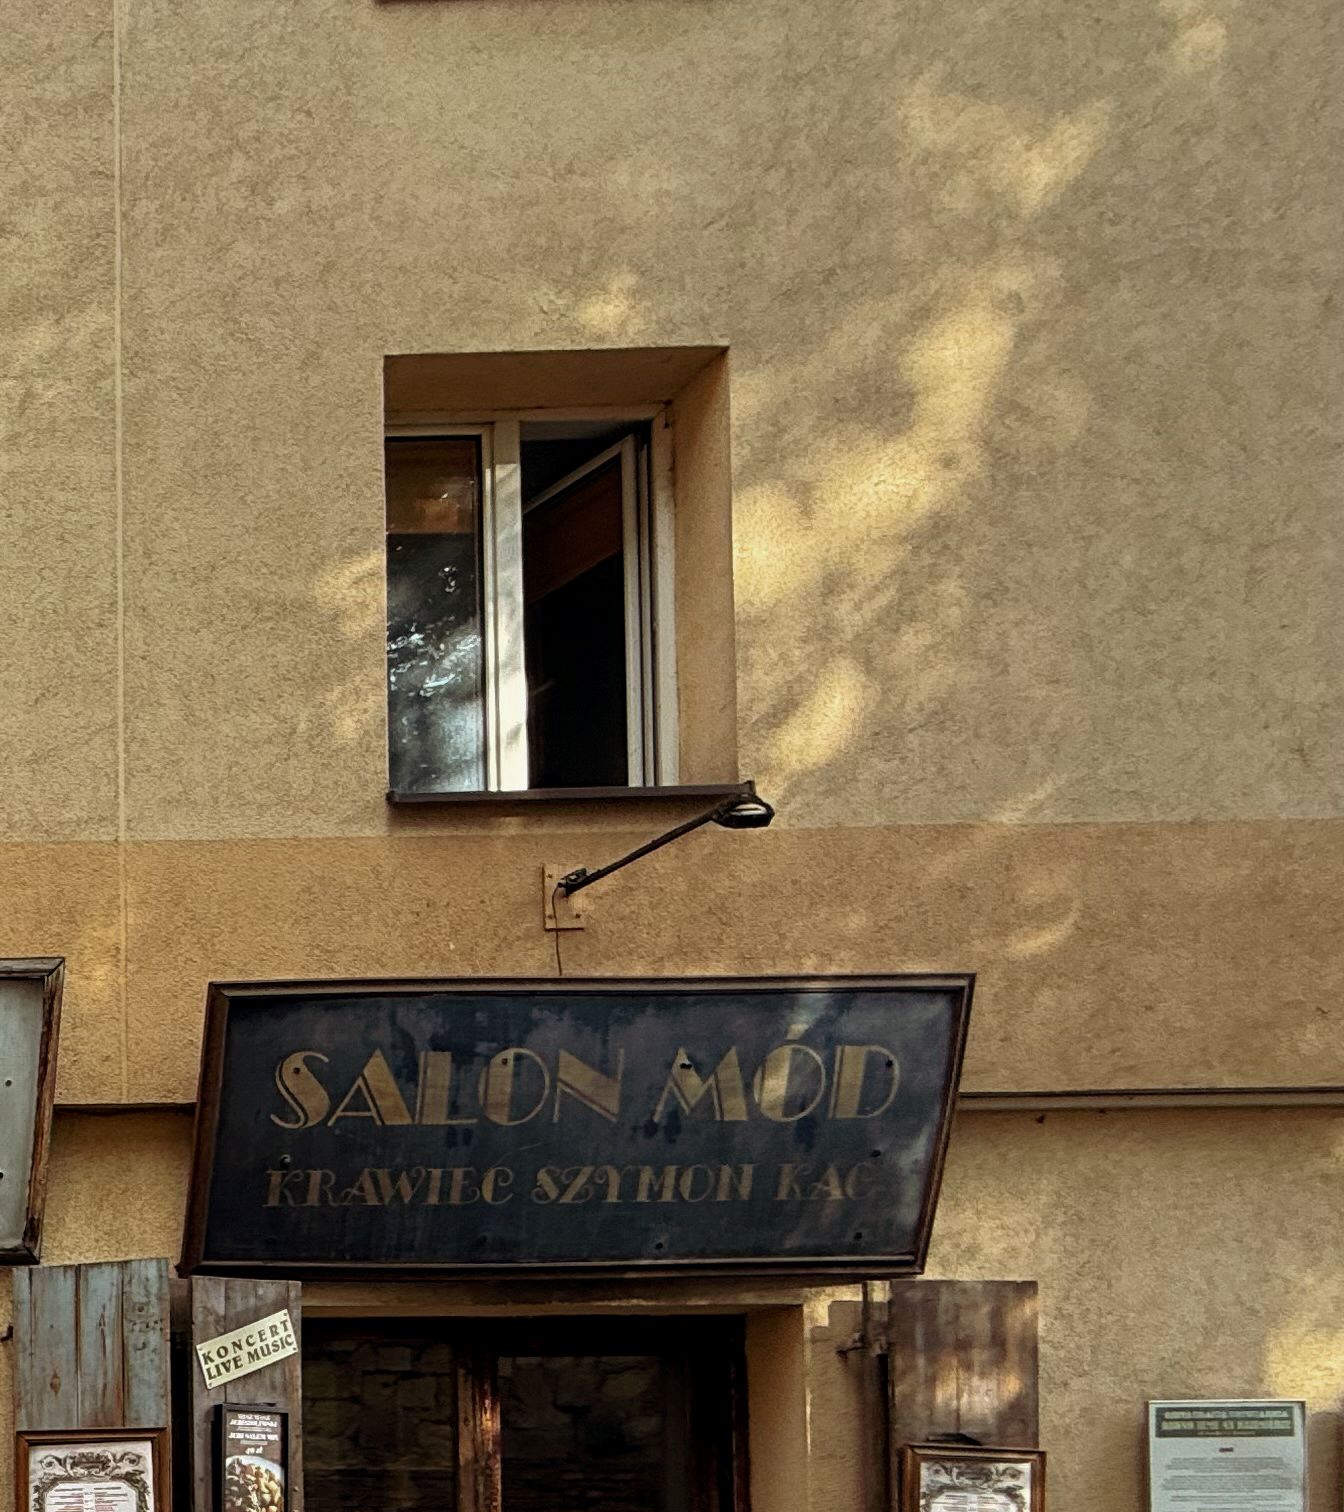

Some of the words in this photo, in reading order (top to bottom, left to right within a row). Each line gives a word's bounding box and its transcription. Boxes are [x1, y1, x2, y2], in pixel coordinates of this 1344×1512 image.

[270, 1047, 624, 1129] SALON
[653, 1023, 900, 1122] MÓD
[262, 1166, 514, 1207] KRAWIEC
[531, 1162, 756, 1204] SZYMON
[202, 1320, 289, 1365] KONCERT
[206, 1355, 243, 1380] LIVE
[247, 1334, 294, 1364] MUSIC
